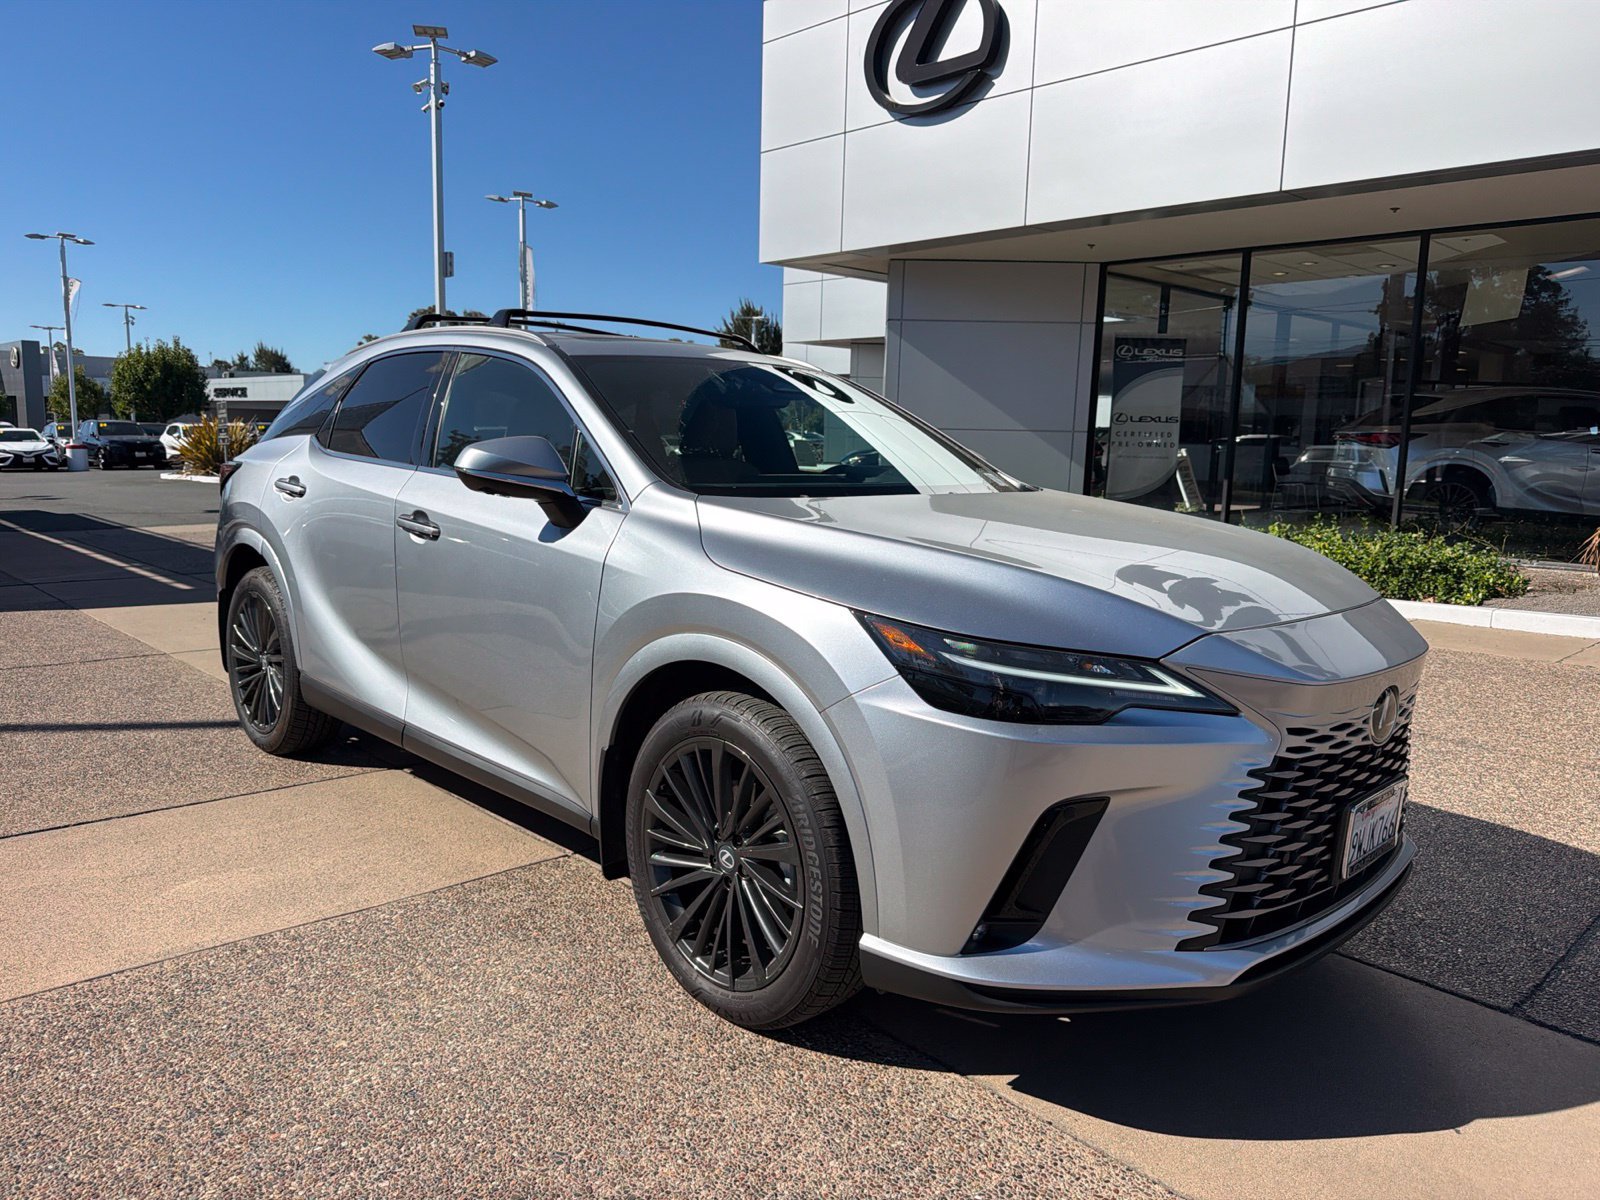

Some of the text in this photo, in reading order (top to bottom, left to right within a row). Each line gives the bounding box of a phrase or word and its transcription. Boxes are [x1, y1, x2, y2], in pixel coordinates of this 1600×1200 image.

[1135, 348, 1182, 356] LEXUS
[1131, 416, 1179, 424] LEXUS
[1112, 441, 1175, 449] PRE-OWNED
[790, 794, 824, 949] BRIDGESTONE
